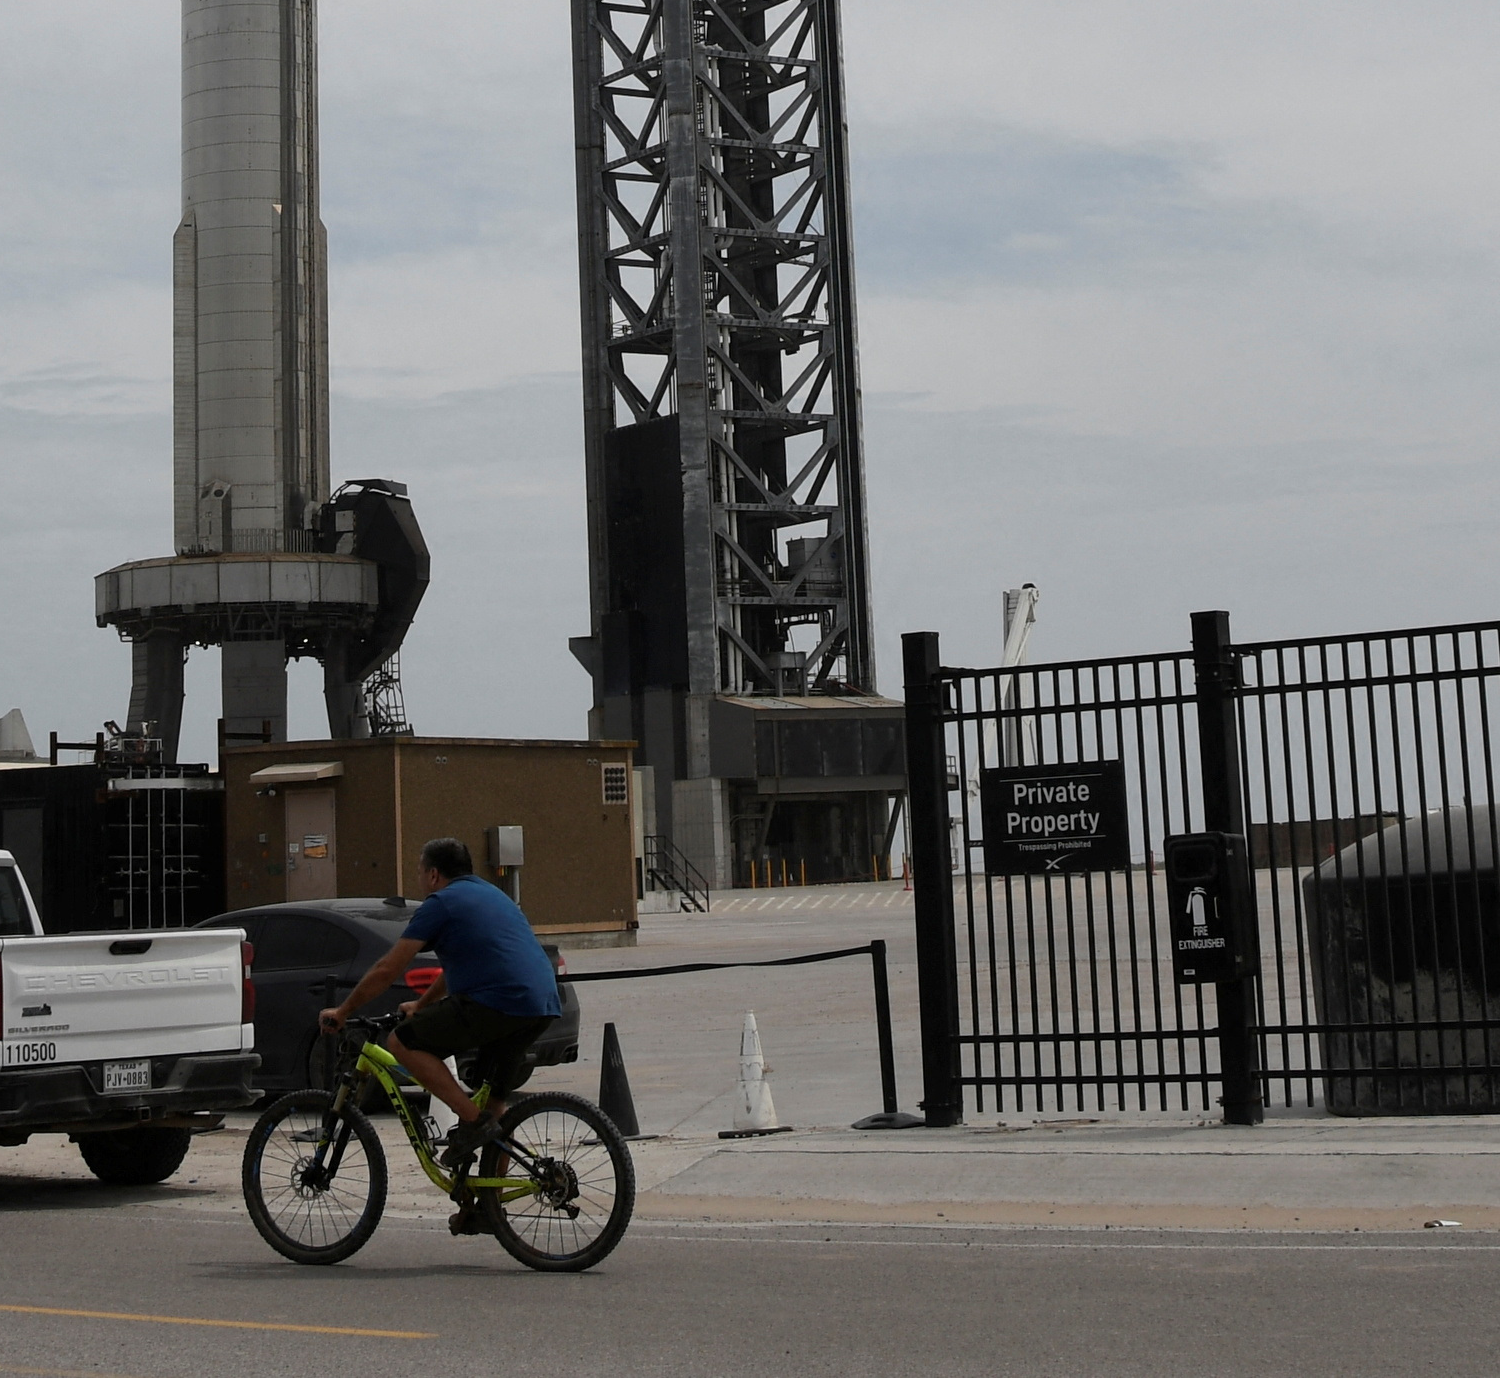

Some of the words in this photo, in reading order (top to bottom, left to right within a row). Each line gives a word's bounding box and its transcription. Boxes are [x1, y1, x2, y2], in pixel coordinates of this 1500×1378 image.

[1013, 781, 1090, 806] Private
[1006, 809, 1100, 837] Property
[1018, 842, 1057, 852] Trespassing
[1057, 841, 1092, 850] Prohibited
[1192, 925, 1209, 937] FIRE
[1178, 937, 1226, 950] EXTINGUISHER
[23, 965, 229, 994] CHEVROLET
[7, 1024, 70, 1034] SILVERADO
[6, 1042, 56, 1063] 110500
[388, 1086, 421, 1152] TREK
